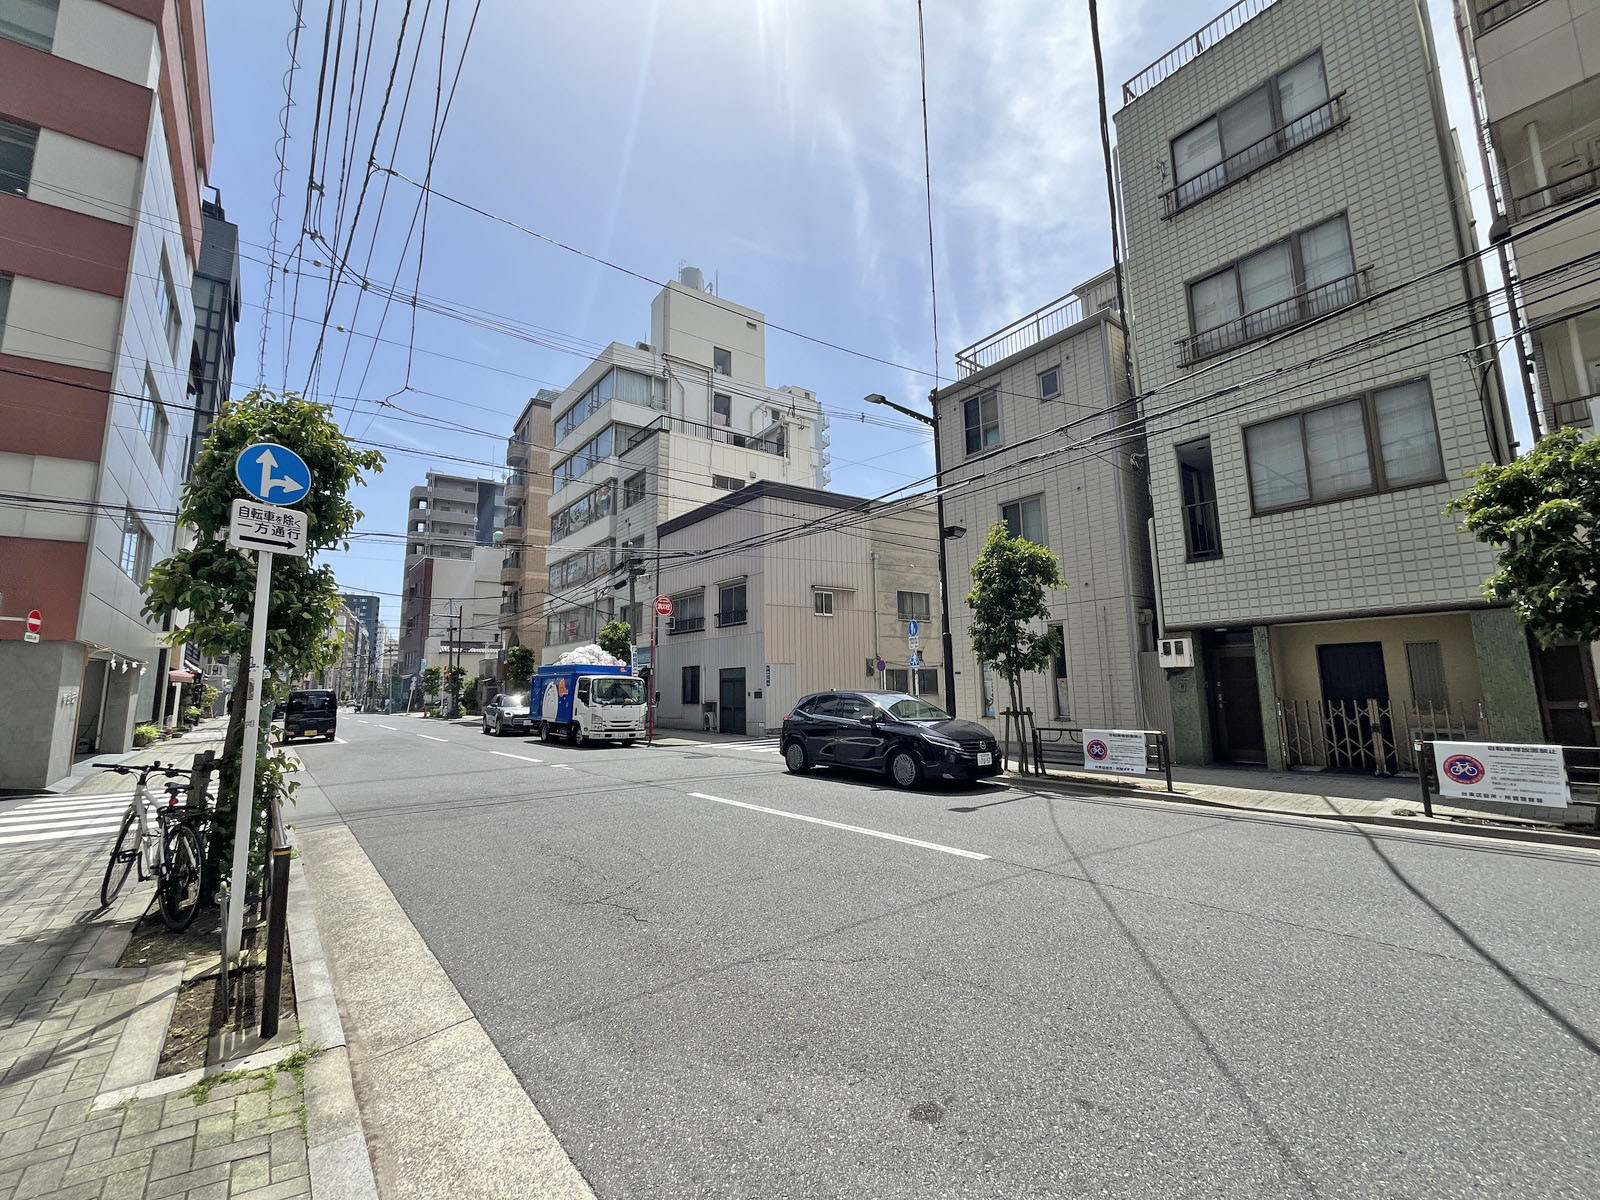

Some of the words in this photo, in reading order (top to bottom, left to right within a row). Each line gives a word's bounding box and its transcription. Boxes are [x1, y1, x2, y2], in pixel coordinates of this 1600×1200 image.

[239, 506, 301, 528] 自転車を除く
[237, 522, 301, 540] 一方通行
